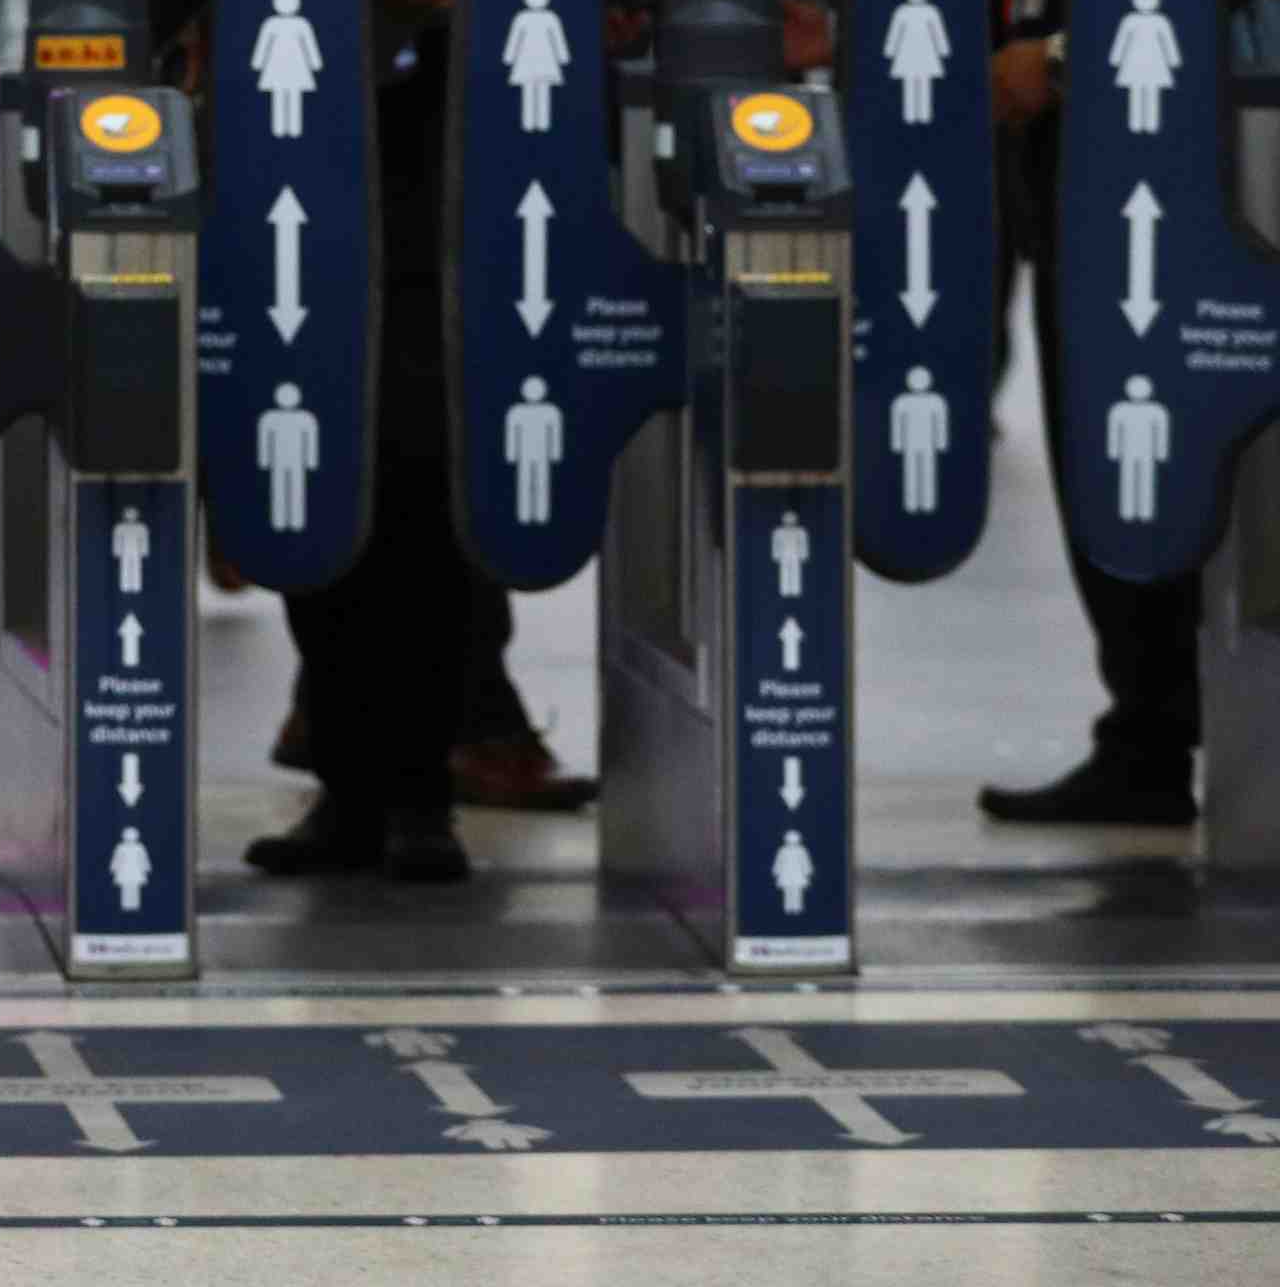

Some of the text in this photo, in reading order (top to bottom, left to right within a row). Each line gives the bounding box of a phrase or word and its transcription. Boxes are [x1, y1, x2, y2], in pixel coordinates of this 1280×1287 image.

[586, 296, 648, 316] Please
[1197, 298, 1263, 319] Please
[571, 322, 662, 346] keep your
[1180, 324, 1278, 349] keep your
[578, 349, 656, 368] distance
[1185, 350, 1271, 371] distance
[98, 675, 163, 694] Please
[759, 679, 822, 699] Please
[83, 700, 176, 724] keep your
[744, 704, 837, 727] keep your
[89, 724, 172, 744] distance
[750, 728, 830, 748] distance
